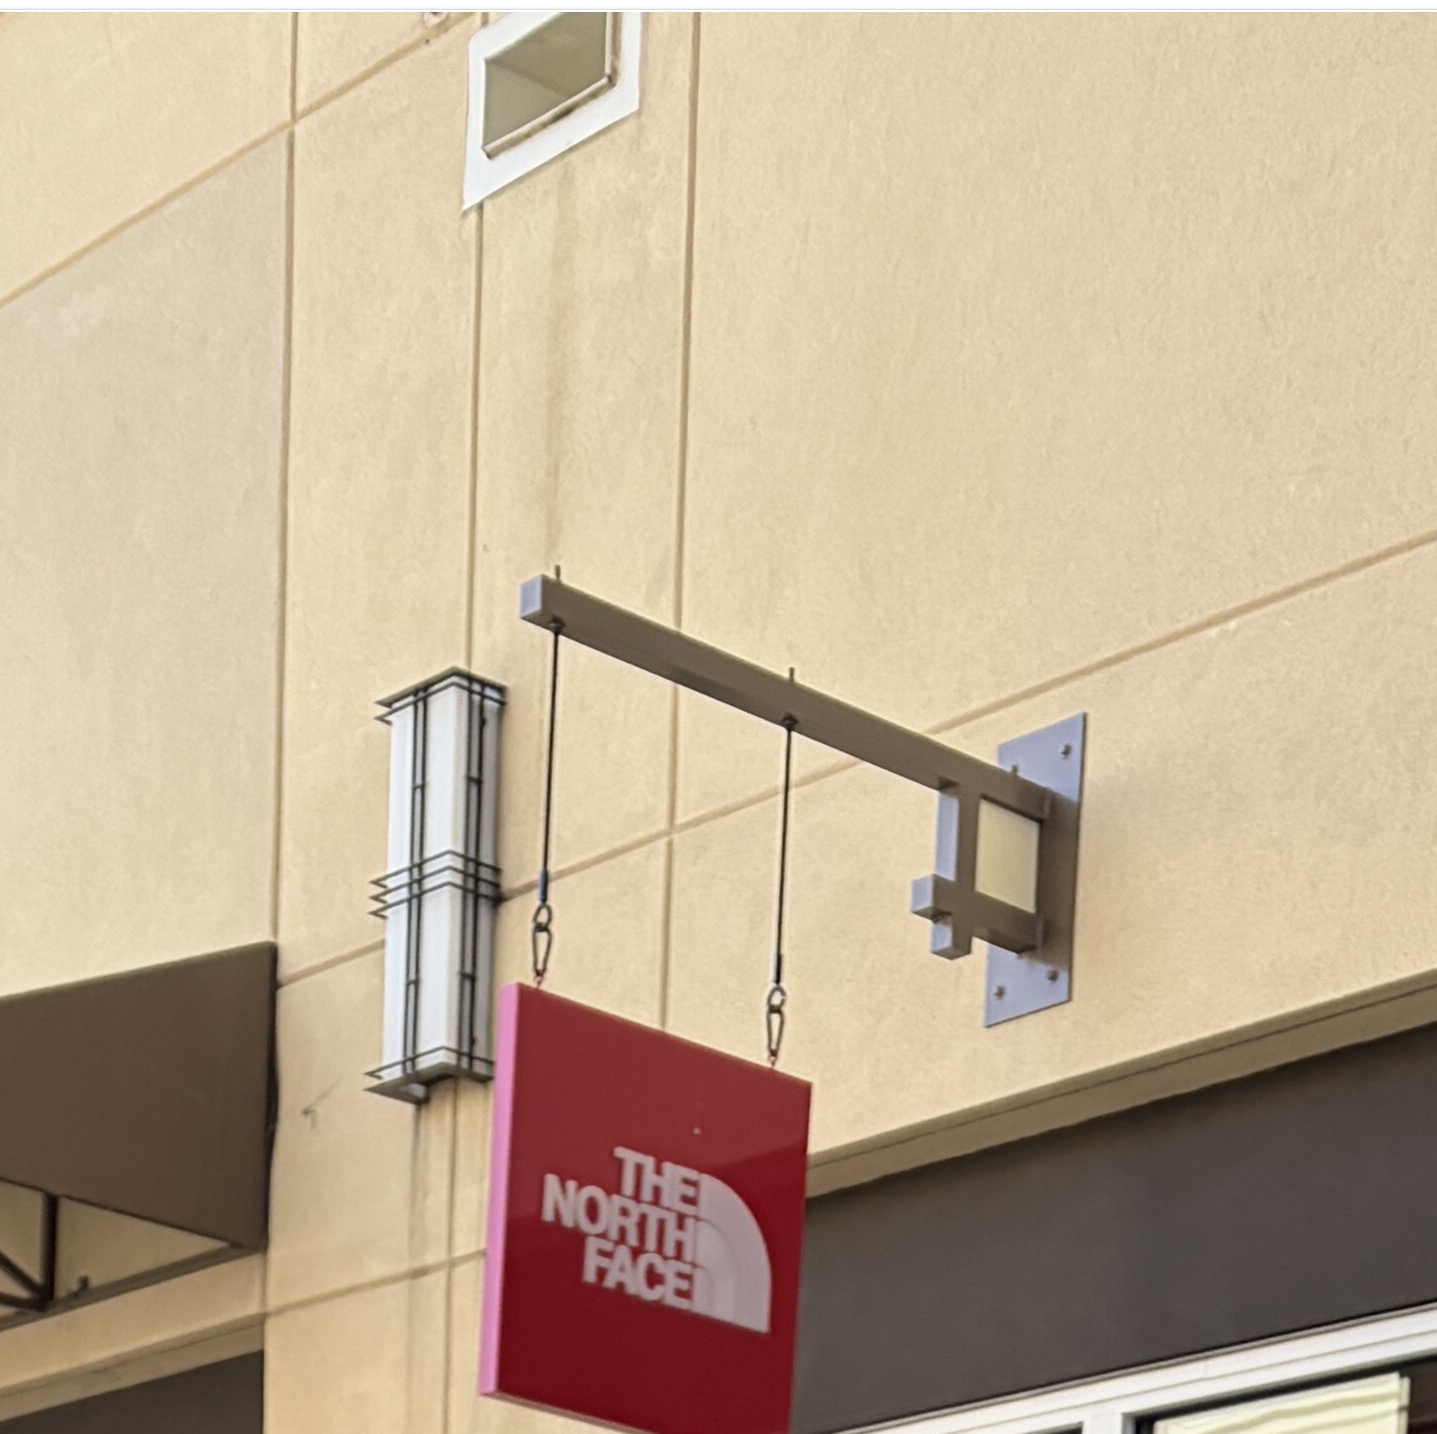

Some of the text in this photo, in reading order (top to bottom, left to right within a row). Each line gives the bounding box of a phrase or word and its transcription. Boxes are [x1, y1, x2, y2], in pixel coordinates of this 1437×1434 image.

[541, 1173, 696, 1264] NORTH
[613, 1146, 700, 1217] THE
[582, 1235, 694, 1311] FACE
